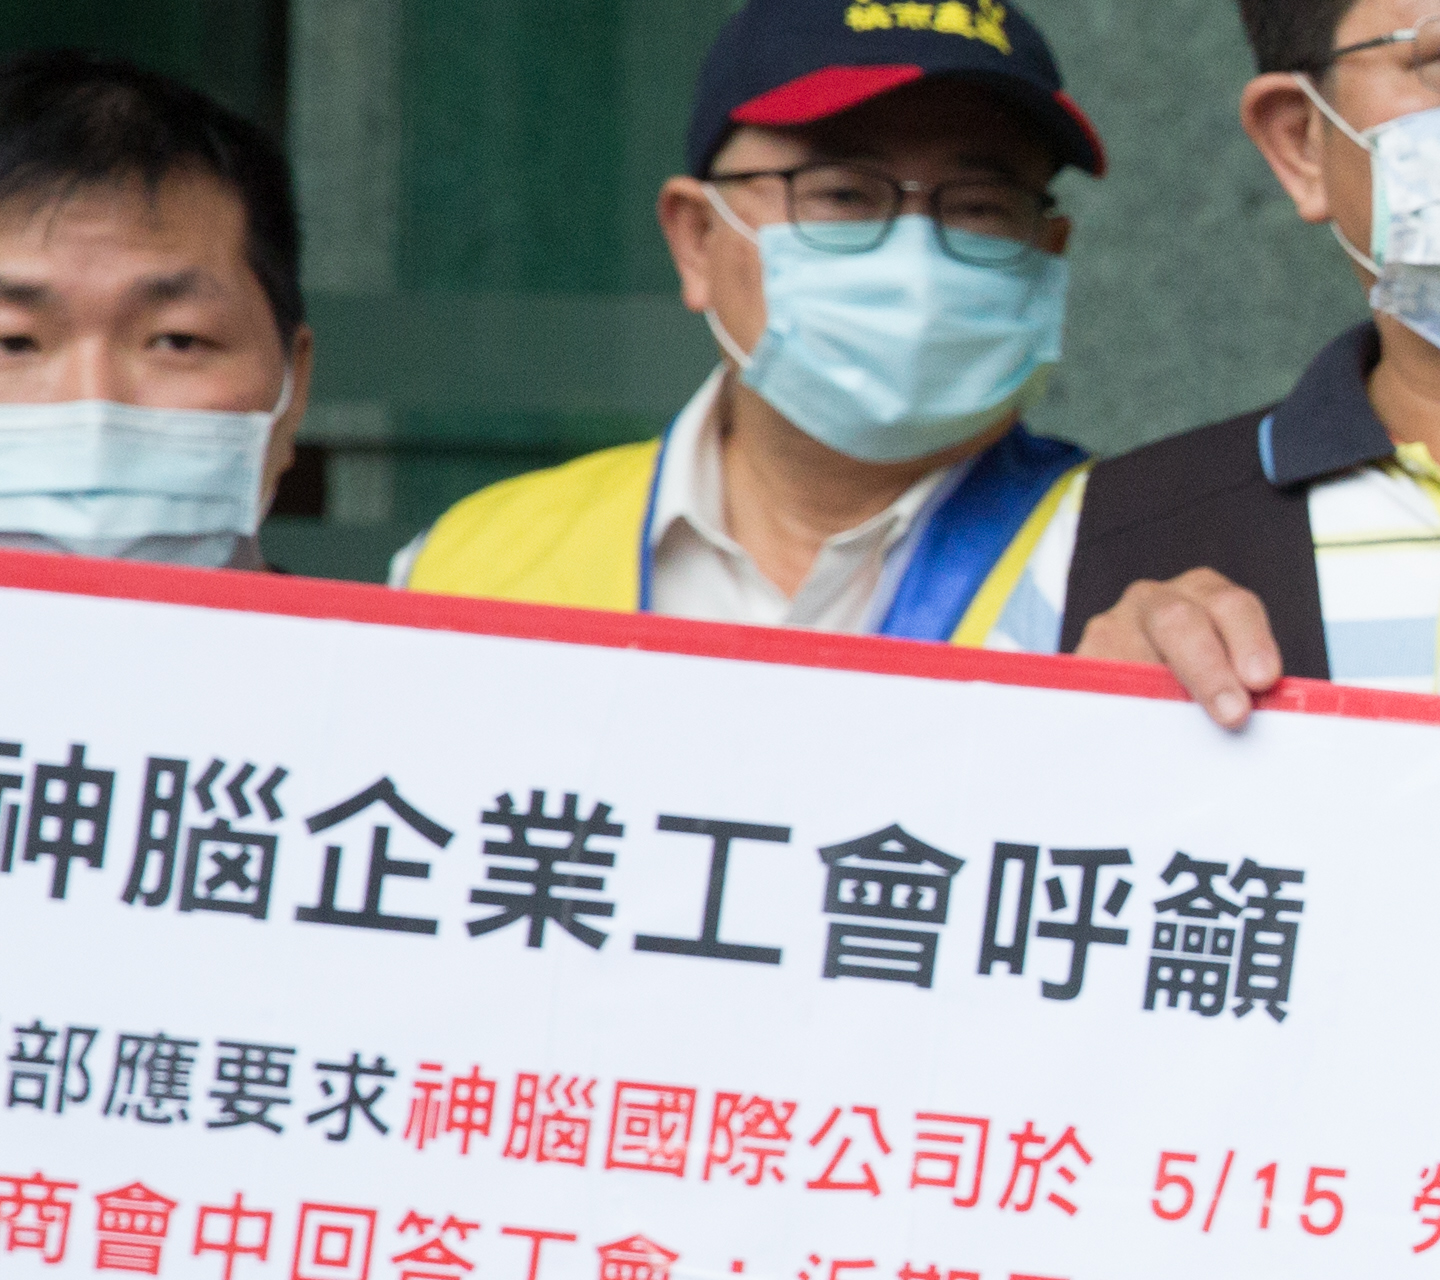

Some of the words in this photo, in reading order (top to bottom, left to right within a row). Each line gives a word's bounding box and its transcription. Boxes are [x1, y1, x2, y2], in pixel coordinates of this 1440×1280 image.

[0, 740, 1306, 1025] 神腦企業工會呼籲
[5, 1018, 1096, 1219] 部應要求神腦國際公司於
[1150, 1149, 1349, 1238] 5/15
